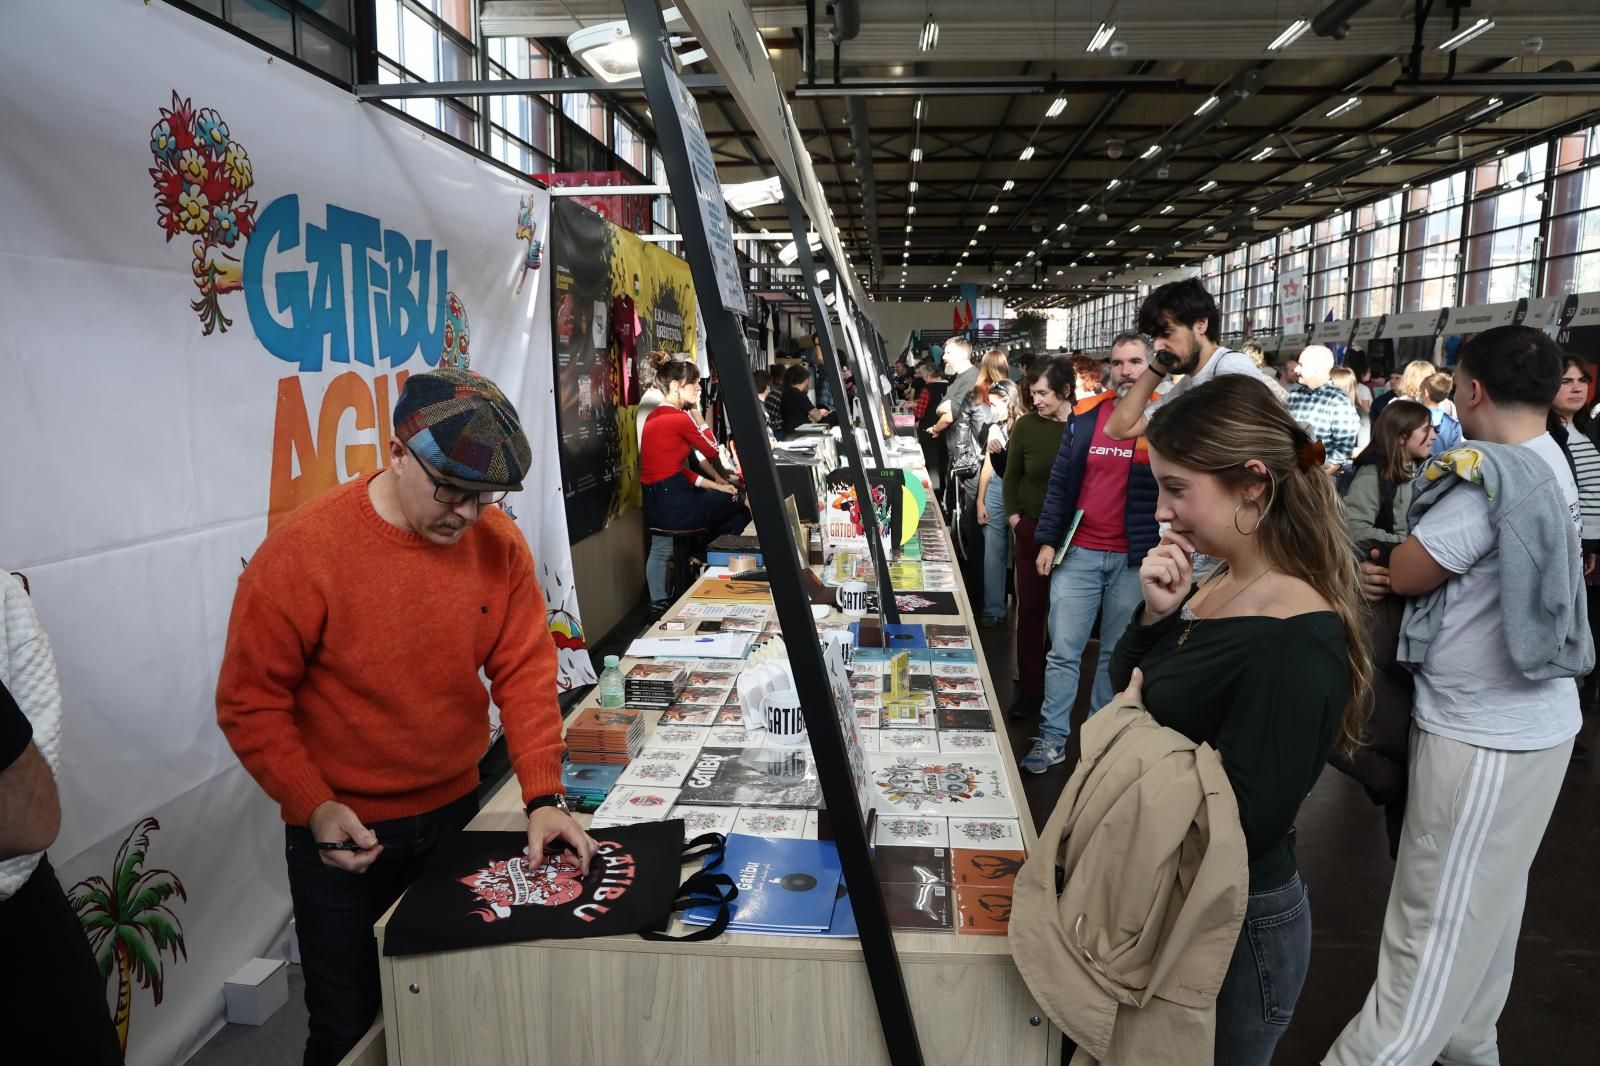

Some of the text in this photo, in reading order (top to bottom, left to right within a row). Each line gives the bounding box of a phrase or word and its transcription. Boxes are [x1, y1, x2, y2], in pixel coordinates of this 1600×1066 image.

[1566, 307, 1575, 317] 53
[1089, 446, 1133, 458] carha
[768, 706, 806, 735] GATIB
[688, 754, 722, 789] GATIBU
[574, 841, 636, 922] GATIBU
[736, 862, 761, 890] Gatibu
